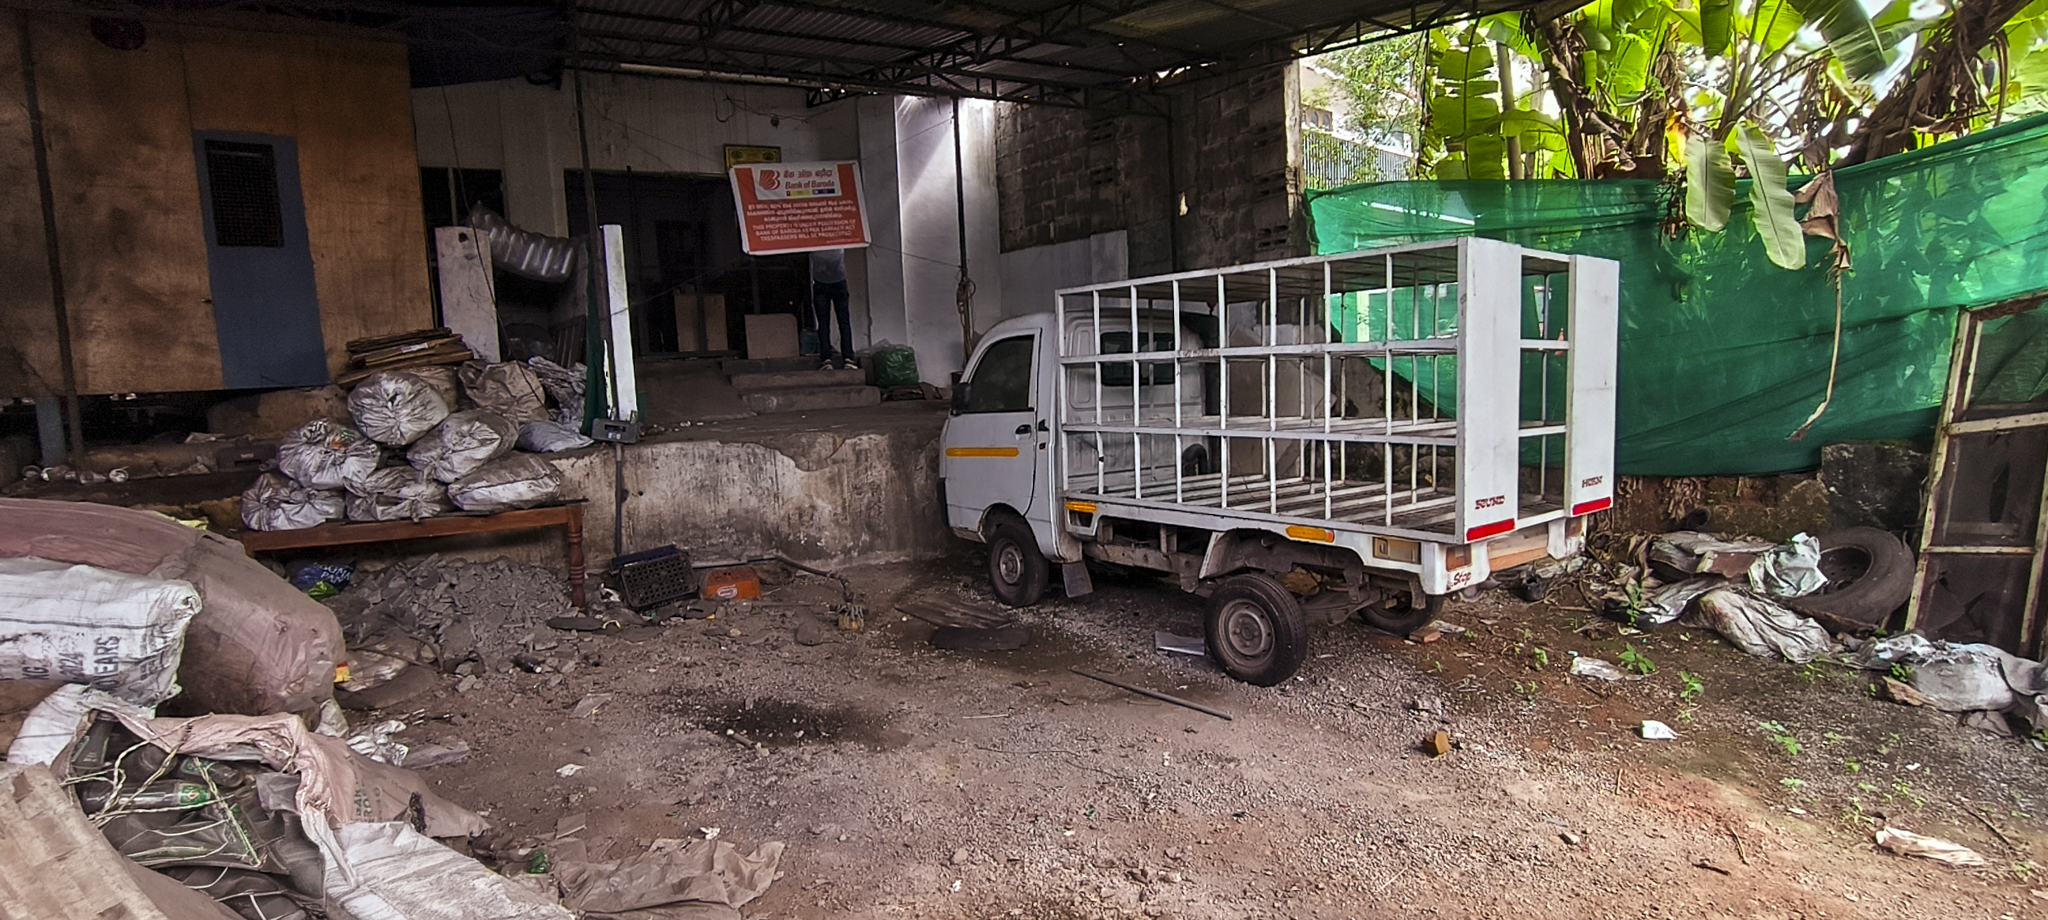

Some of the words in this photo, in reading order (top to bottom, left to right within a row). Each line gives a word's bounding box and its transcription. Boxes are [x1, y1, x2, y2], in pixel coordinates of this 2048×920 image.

[785, 181, 803, 189] Bank
[803, 179, 811, 188] of
[811, 179, 835, 188] Baroda
[765, 222, 792, 230] PROPERTY
[1475, 495, 1505, 510] SOUND
[1453, 570, 1472, 586] Stop
